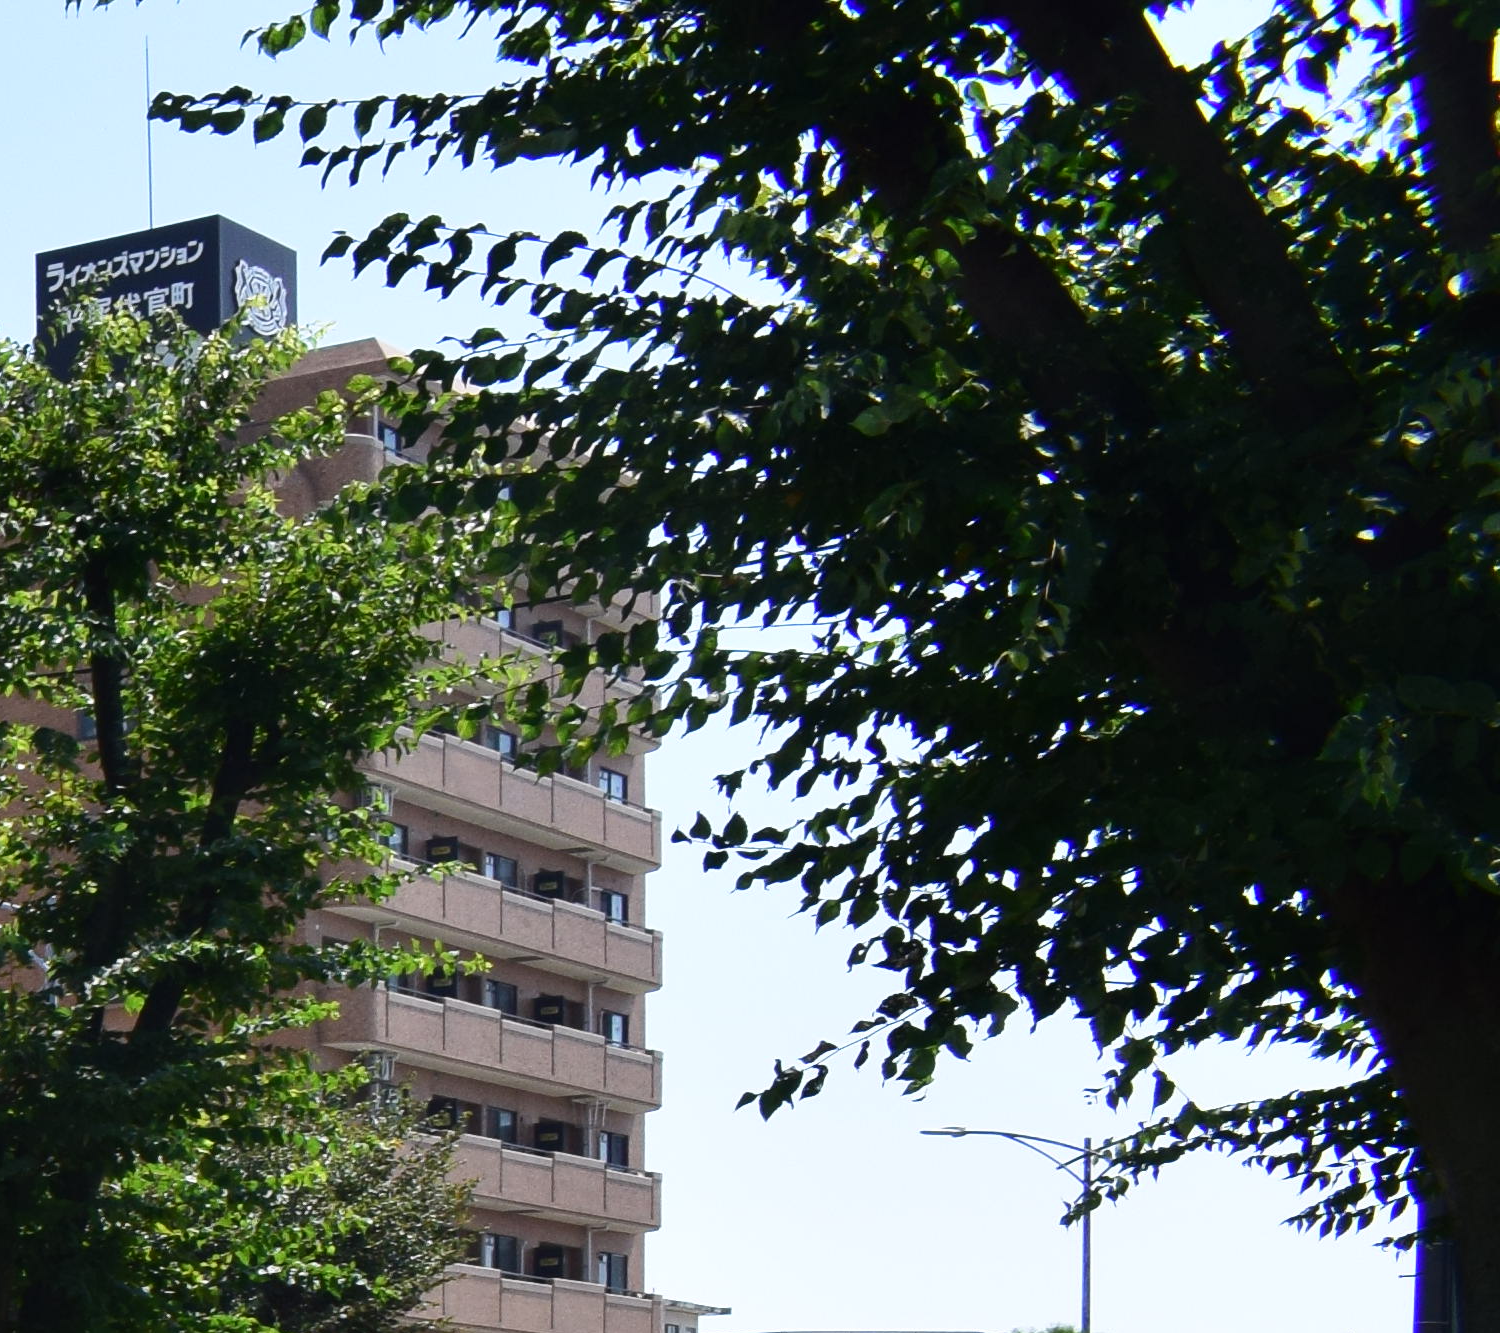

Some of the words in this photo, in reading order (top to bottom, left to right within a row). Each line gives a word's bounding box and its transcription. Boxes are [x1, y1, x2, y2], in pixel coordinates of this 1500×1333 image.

[45, 239, 205, 294] ライオンズマンション
